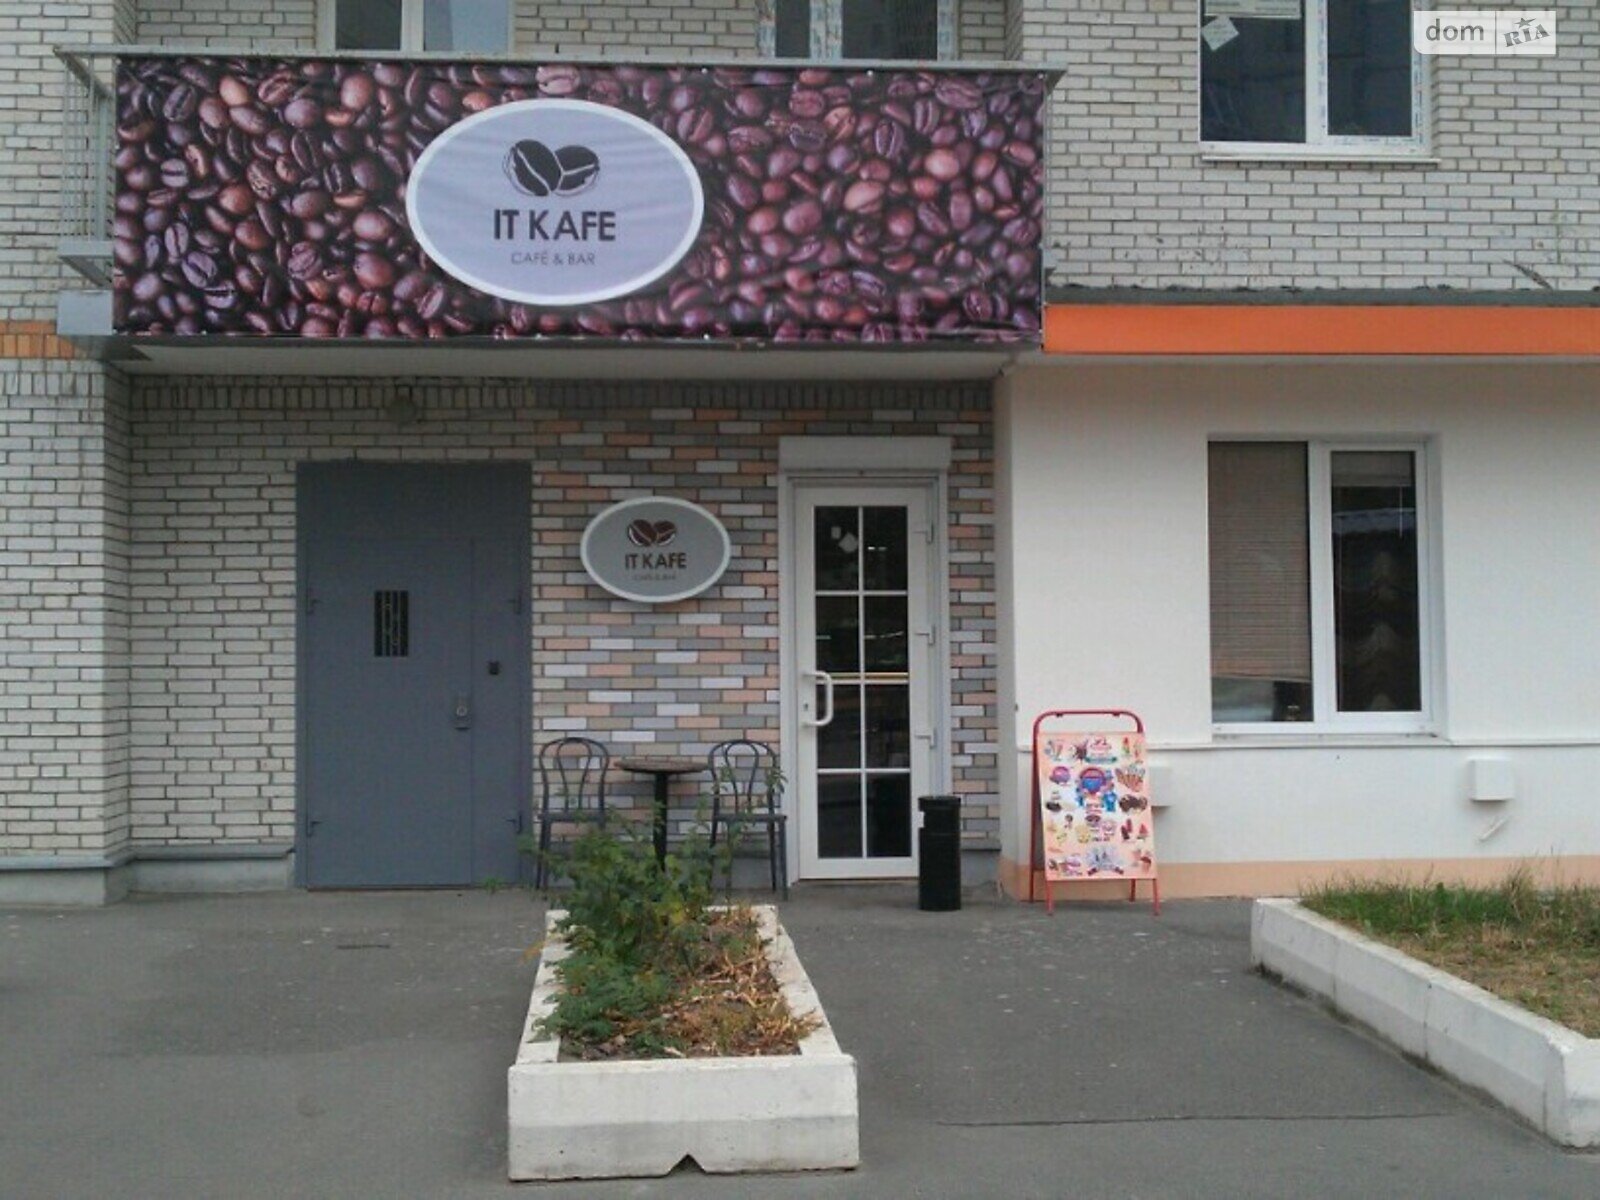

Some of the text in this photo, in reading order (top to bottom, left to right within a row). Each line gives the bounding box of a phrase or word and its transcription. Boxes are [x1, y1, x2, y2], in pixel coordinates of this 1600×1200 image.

[494, 209, 616, 241] IT KAFE
[510, 251, 596, 266] CAFÉ & BAR
[625, 552, 688, 570] IT KAFE
